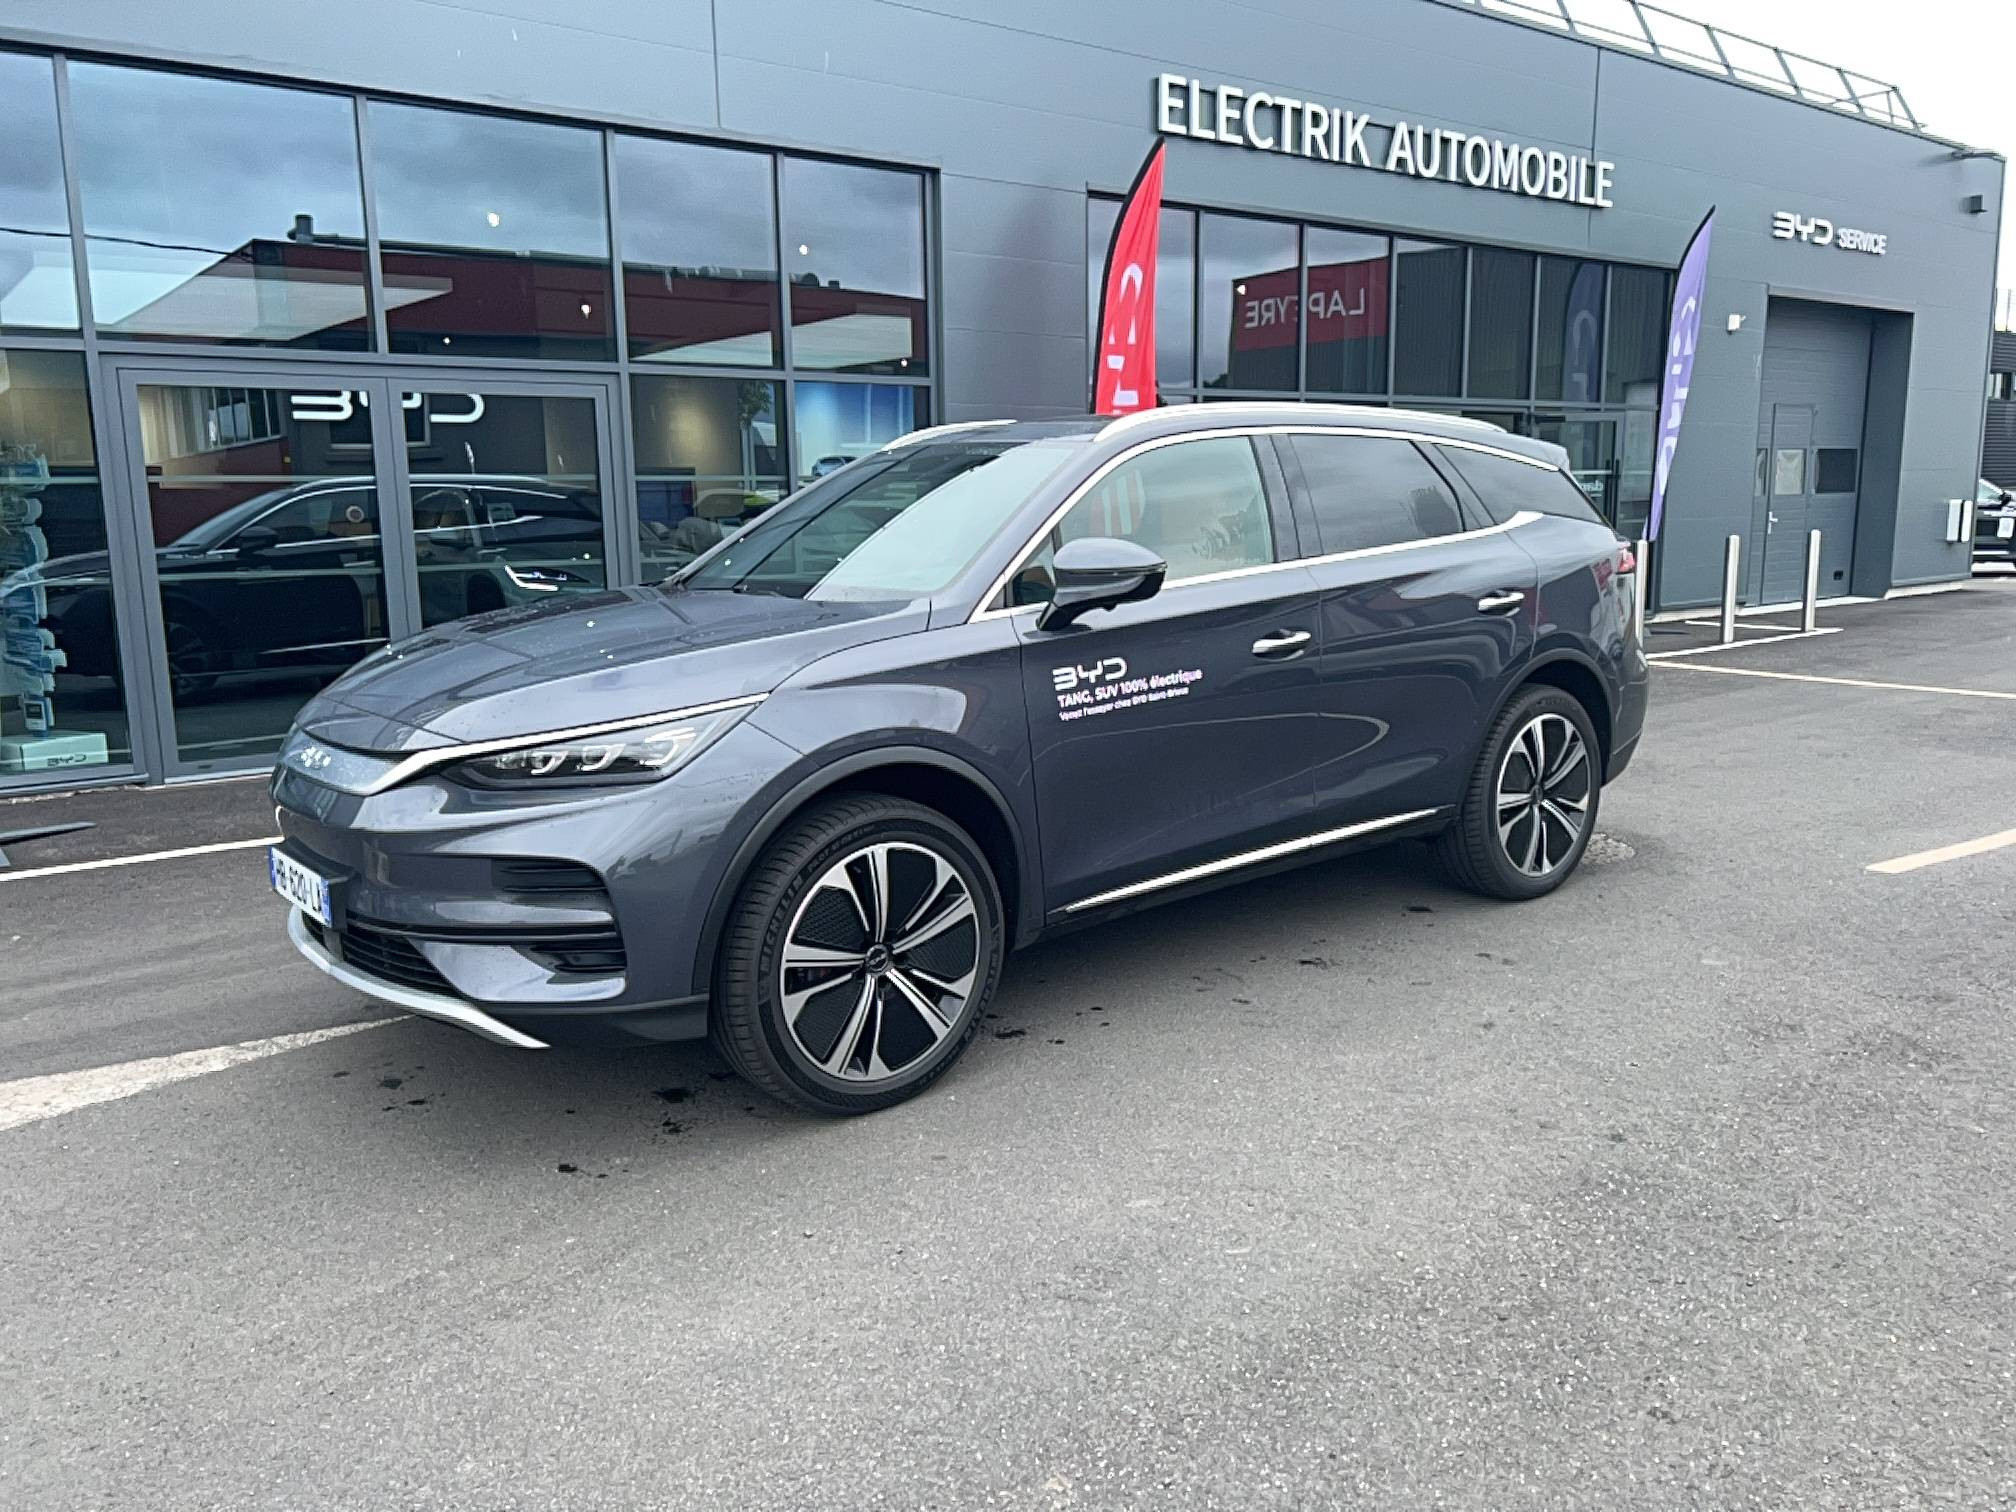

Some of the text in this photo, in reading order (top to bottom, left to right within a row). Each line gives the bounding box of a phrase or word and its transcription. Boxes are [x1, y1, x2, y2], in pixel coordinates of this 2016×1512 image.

[1158, 73, 1614, 208] ELECTRIK AUTOMOBILE
[1773, 211, 1887, 255] BYD SERVICE
[1052, 656, 1128, 691] BYD
[1057, 669, 1203, 708] TANG, SUV 100% électrique
